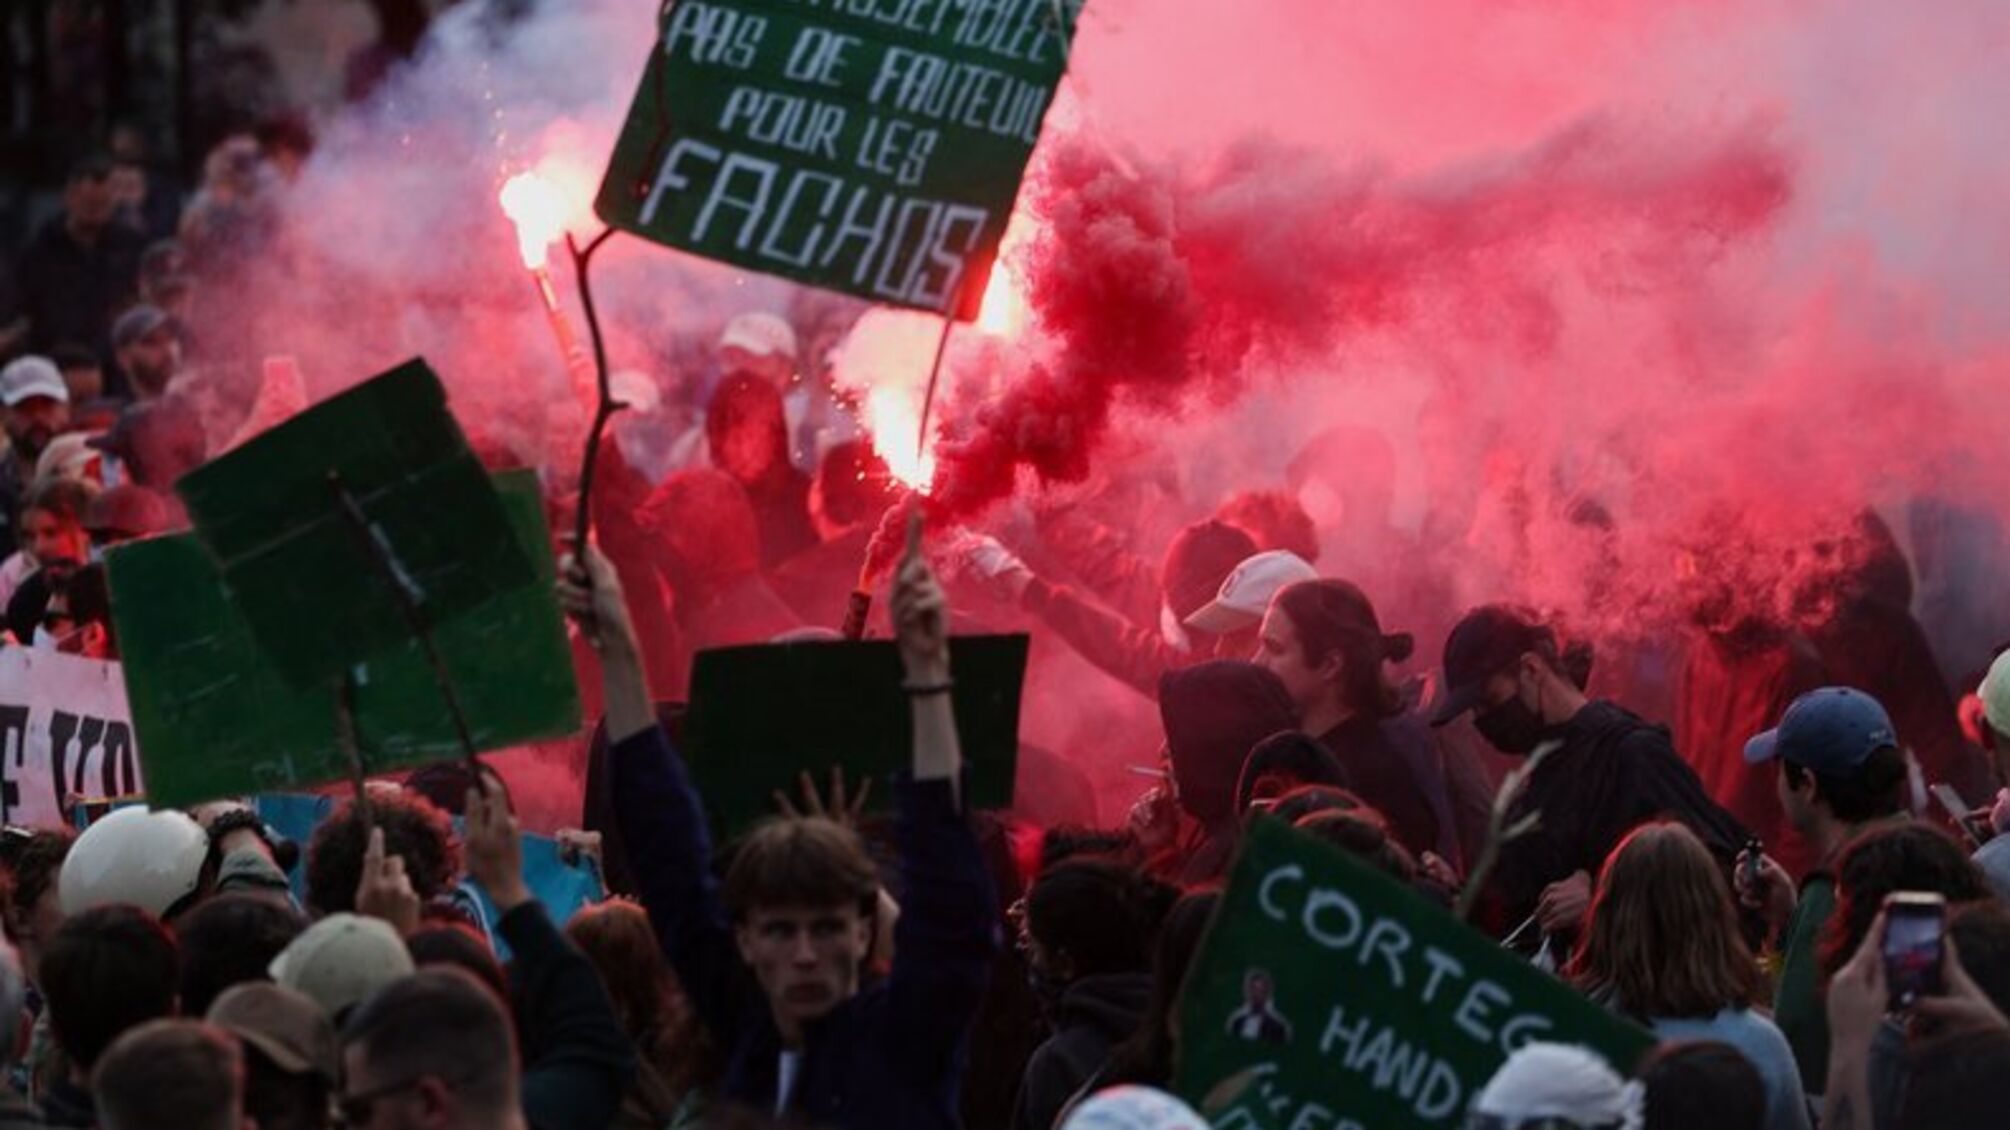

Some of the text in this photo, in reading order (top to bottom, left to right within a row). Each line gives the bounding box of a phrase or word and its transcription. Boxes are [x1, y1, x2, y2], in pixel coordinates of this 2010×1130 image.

[665, 2, 1048, 143] PAS DE FAUTEUIL
[719, 86, 938, 185] POUR LES
[638, 138, 987, 307] FACHOS
